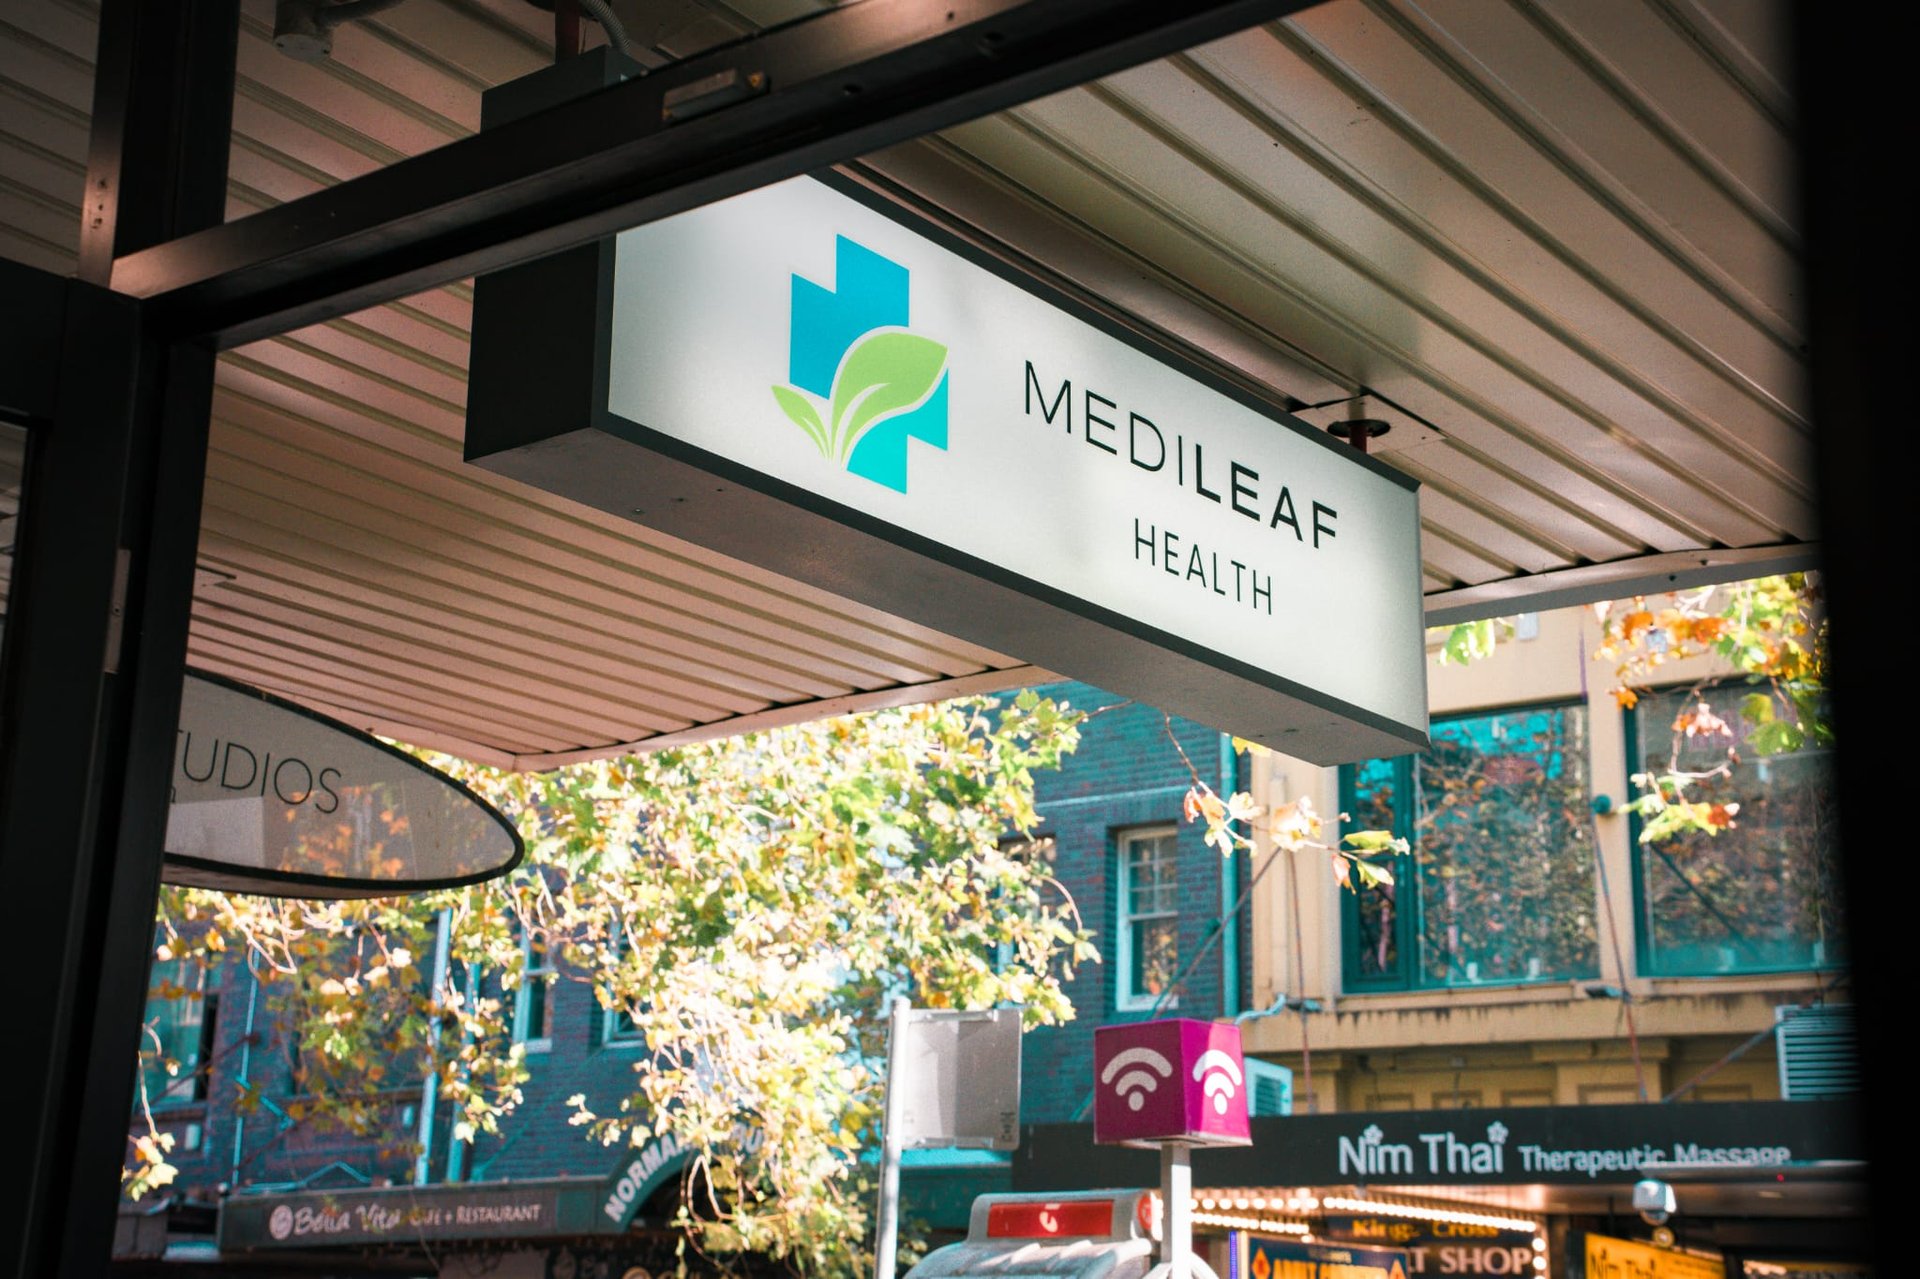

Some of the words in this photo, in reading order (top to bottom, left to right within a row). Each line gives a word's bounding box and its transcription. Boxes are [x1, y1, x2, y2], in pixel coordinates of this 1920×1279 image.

[1025, 359, 1338, 550] MEDILEAF
[1134, 517, 1272, 615] HEALTH
[177, 729, 342, 814] UDIOS
[1338, 1124, 1414, 1175] Nim
[1418, 1120, 1509, 1174] Thai
[1517, 1144, 1666, 1178] Therapeutic
[456, 1203, 542, 1226] RESTAURANT
[1439, 1247, 1533, 1276] SHOP
